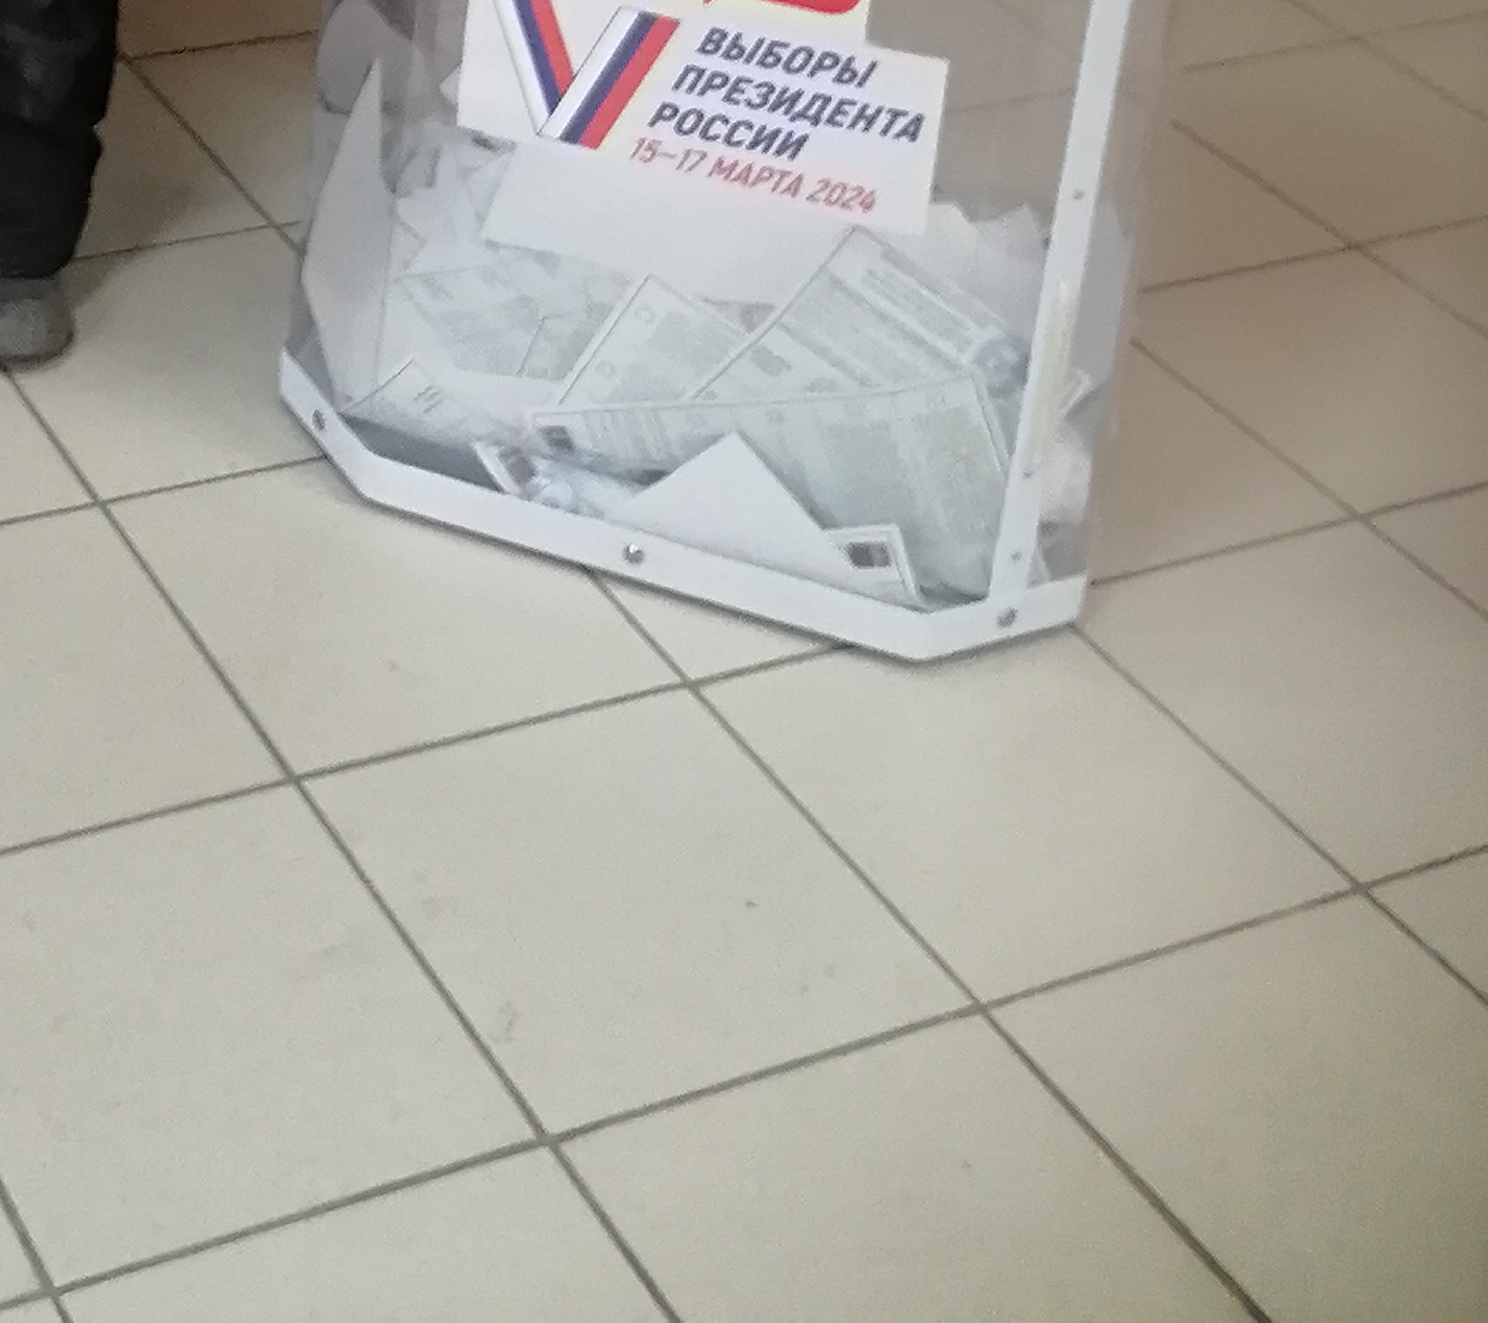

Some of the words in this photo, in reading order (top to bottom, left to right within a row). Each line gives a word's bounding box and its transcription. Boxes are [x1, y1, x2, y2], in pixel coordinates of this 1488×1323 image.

[695, 26, 879, 88] ВЫБОРЫ
[647, 101, 811, 162] РОССИИ
[671, 63, 926, 143] ПРЕЗИДЕНТА
[708, 155, 805, 199] МАРТА
[805, 177, 878, 214] 2024
